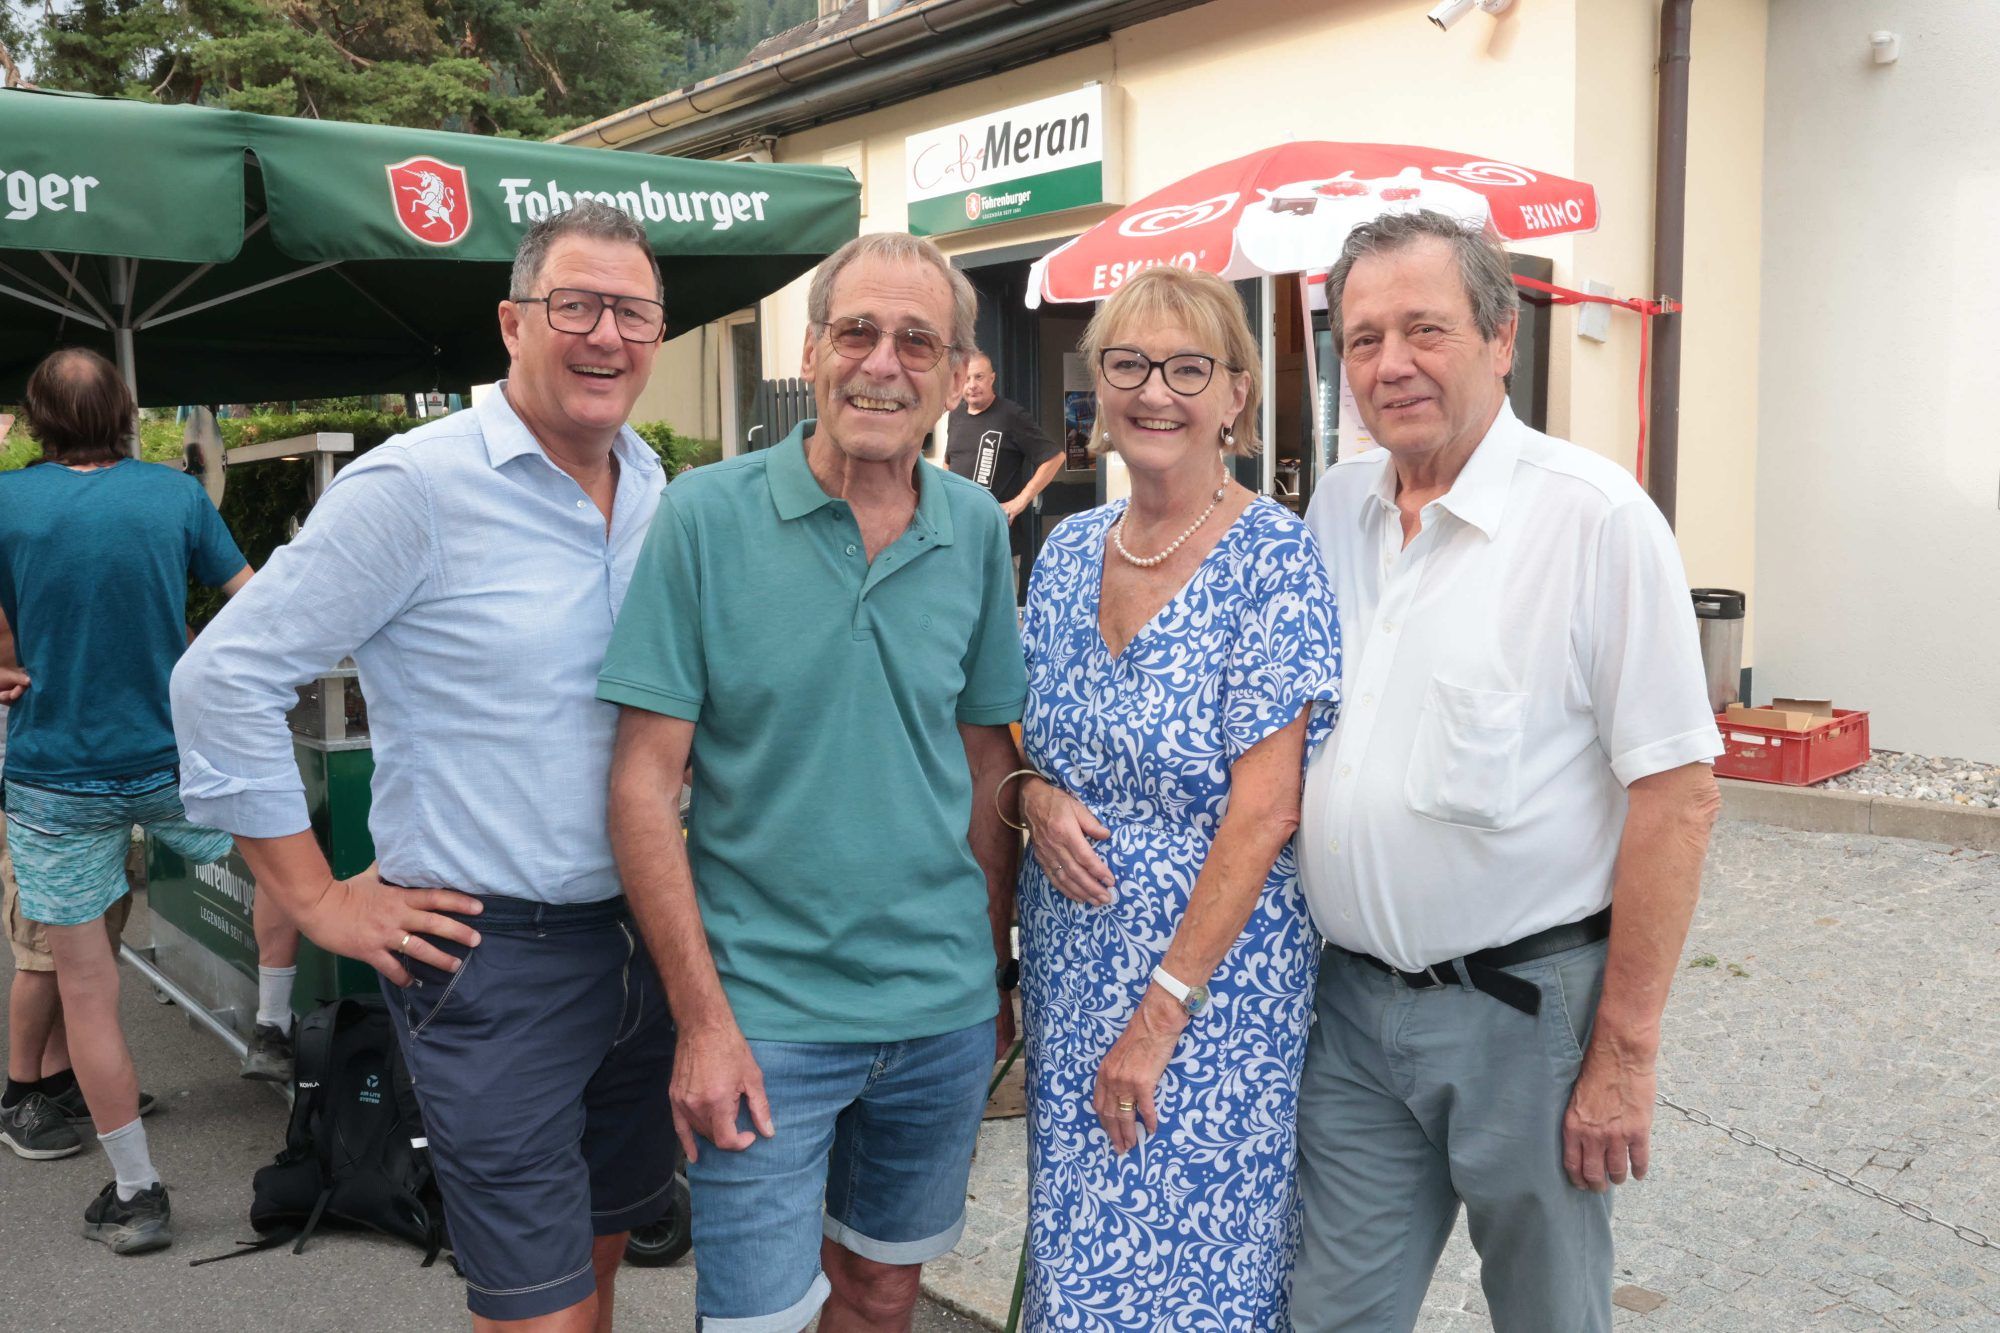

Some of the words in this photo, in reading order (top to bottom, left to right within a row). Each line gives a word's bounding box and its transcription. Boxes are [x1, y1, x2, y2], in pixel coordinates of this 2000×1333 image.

[981, 112, 1090, 172] Meran
[0, 169, 100, 221] ger
[981, 190, 1032, 210] Fohrenburger
[1519, 198, 1582, 230] ESKIMO
[1093, 251, 1197, 291] ESKO
[976, 447, 995, 485] PUMA
[194, 861, 255, 916] ohrenburge
